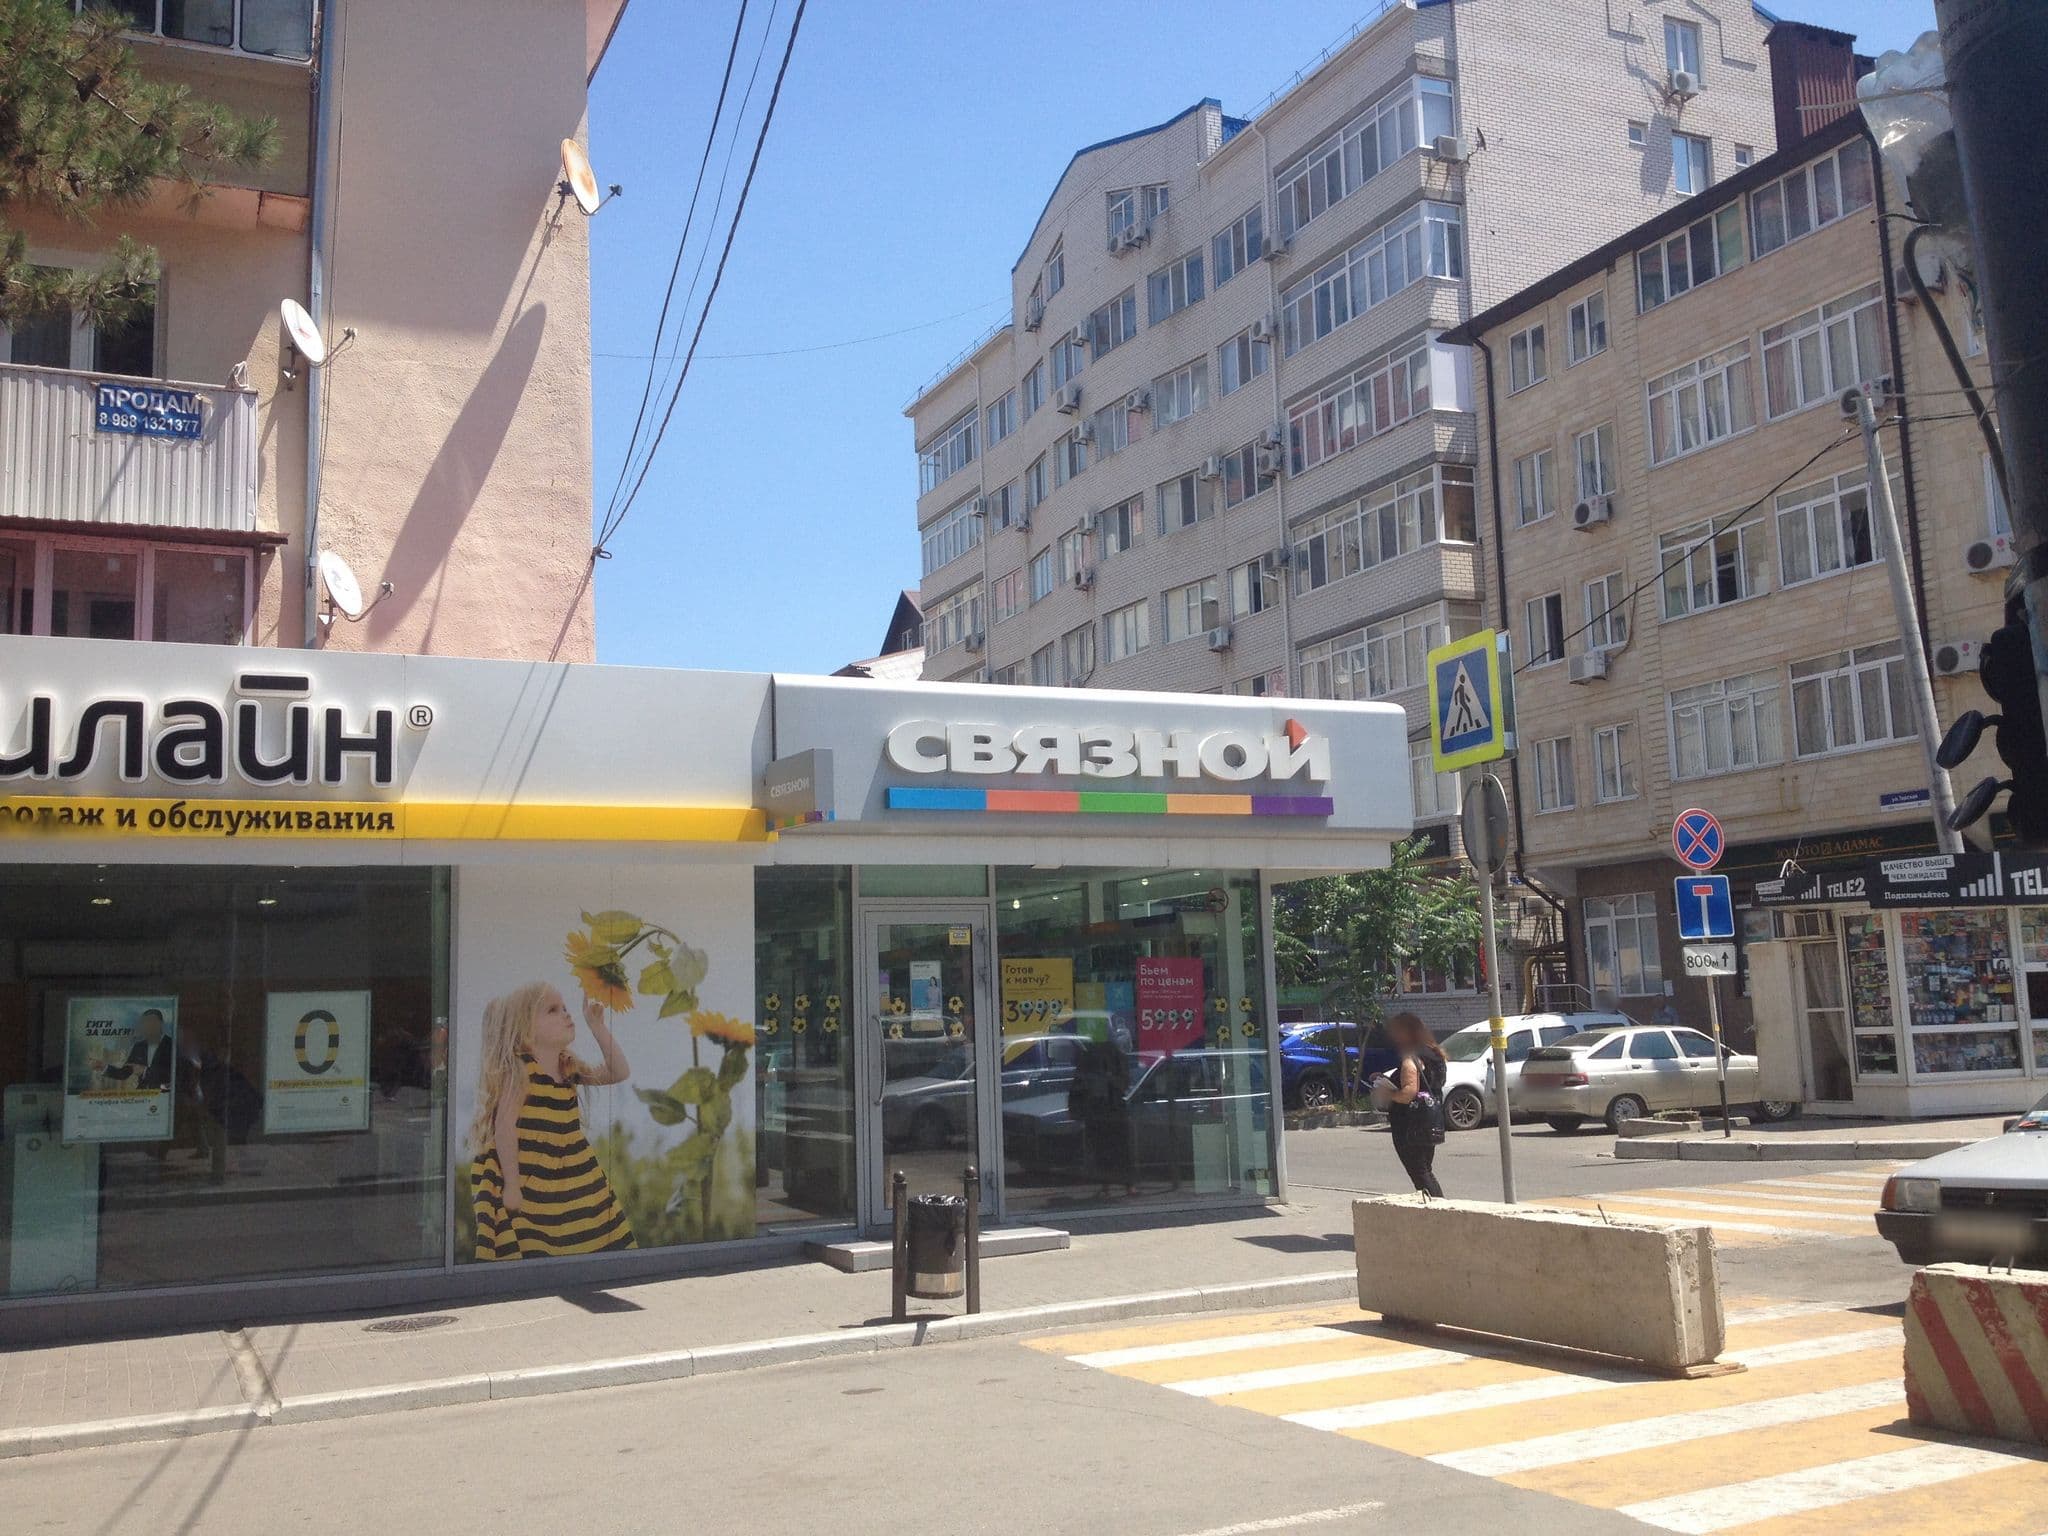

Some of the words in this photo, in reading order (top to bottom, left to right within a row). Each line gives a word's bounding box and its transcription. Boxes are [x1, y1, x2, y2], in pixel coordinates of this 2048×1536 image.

[100, 387, 200, 415] ПРОДАМ
[100, 411, 108, 426] 8
[112, 412, 138, 428] 988
[142, 415, 199, 433] 1321377
[886, 719, 1332, 782] СВЯЗНОЙ
[116, 806, 137, 828] и
[148, 802, 395, 837] обслуживания
[1883, 860, 1923, 872] КАЧЕСТВО
[1826, 877, 1866, 899] TELE2
[1005, 964, 1034, 974] Готов
[1014, 974, 1050, 986] матчу?
[1140, 977, 1155, 986] по
[1158, 977, 1194, 988] ценам
[86, 1019, 113, 1029] ГИГИ
[86, 1028, 99, 1037] ЗА
